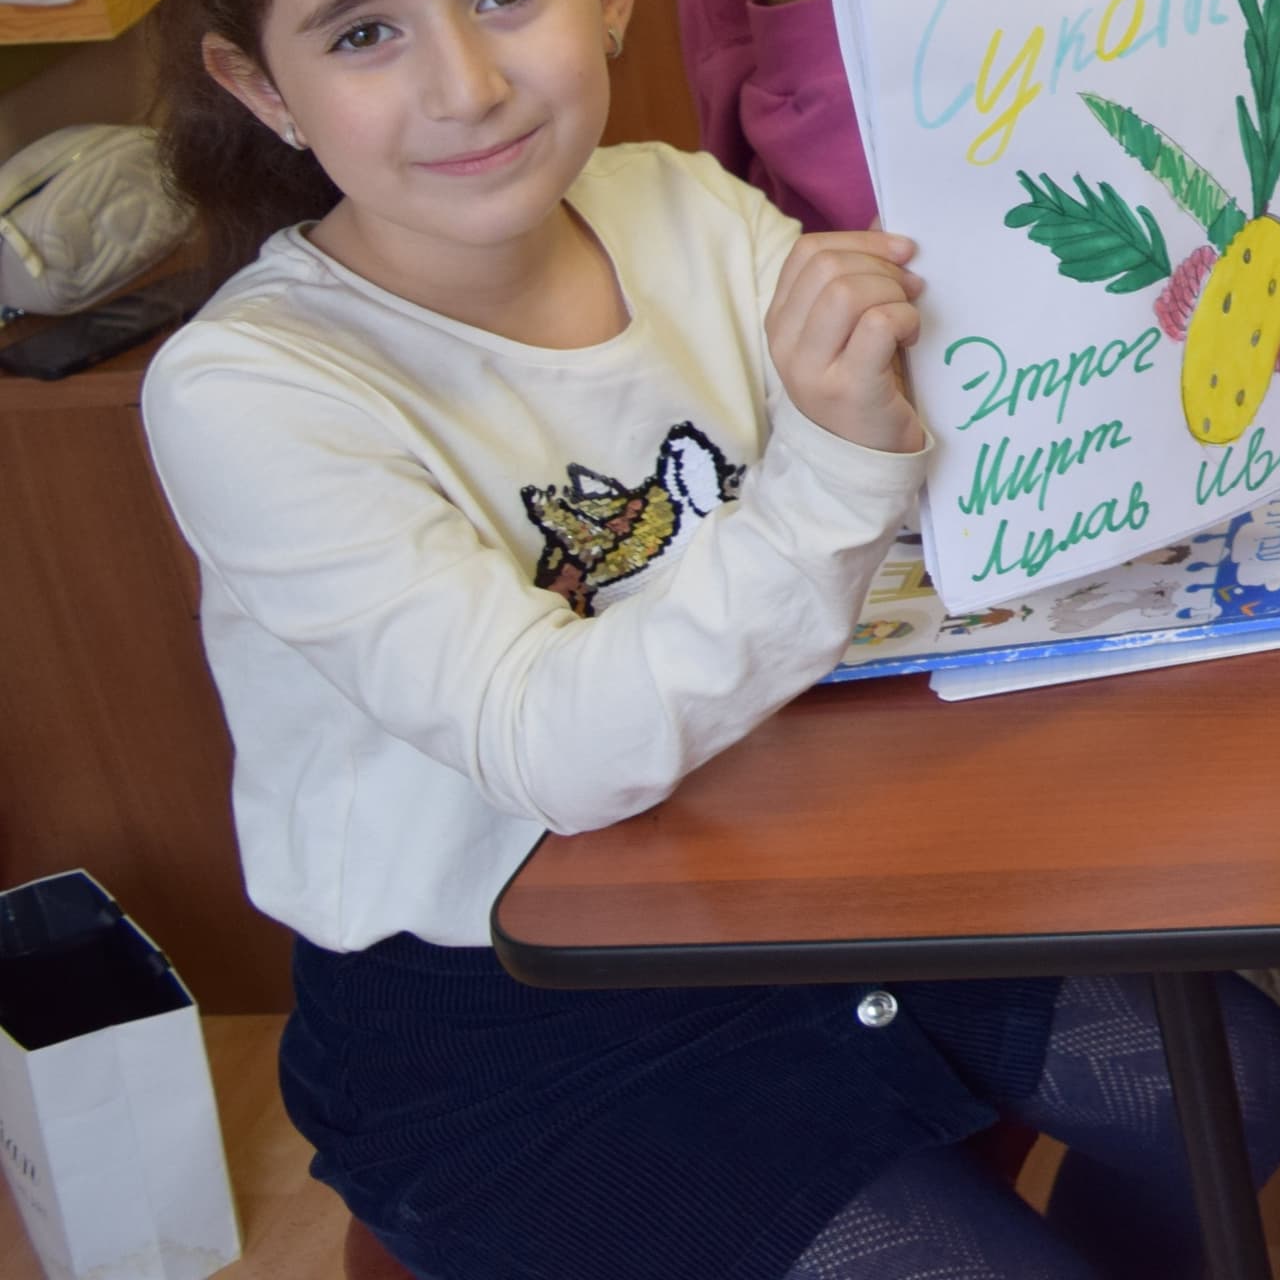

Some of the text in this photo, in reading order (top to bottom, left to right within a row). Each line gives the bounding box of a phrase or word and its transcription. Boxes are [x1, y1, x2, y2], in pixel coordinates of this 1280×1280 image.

[943, 325, 1164, 432] Этрог
[958, 417, 1132, 518] Мирт
[971, 479, 1151, 583] Лулав
